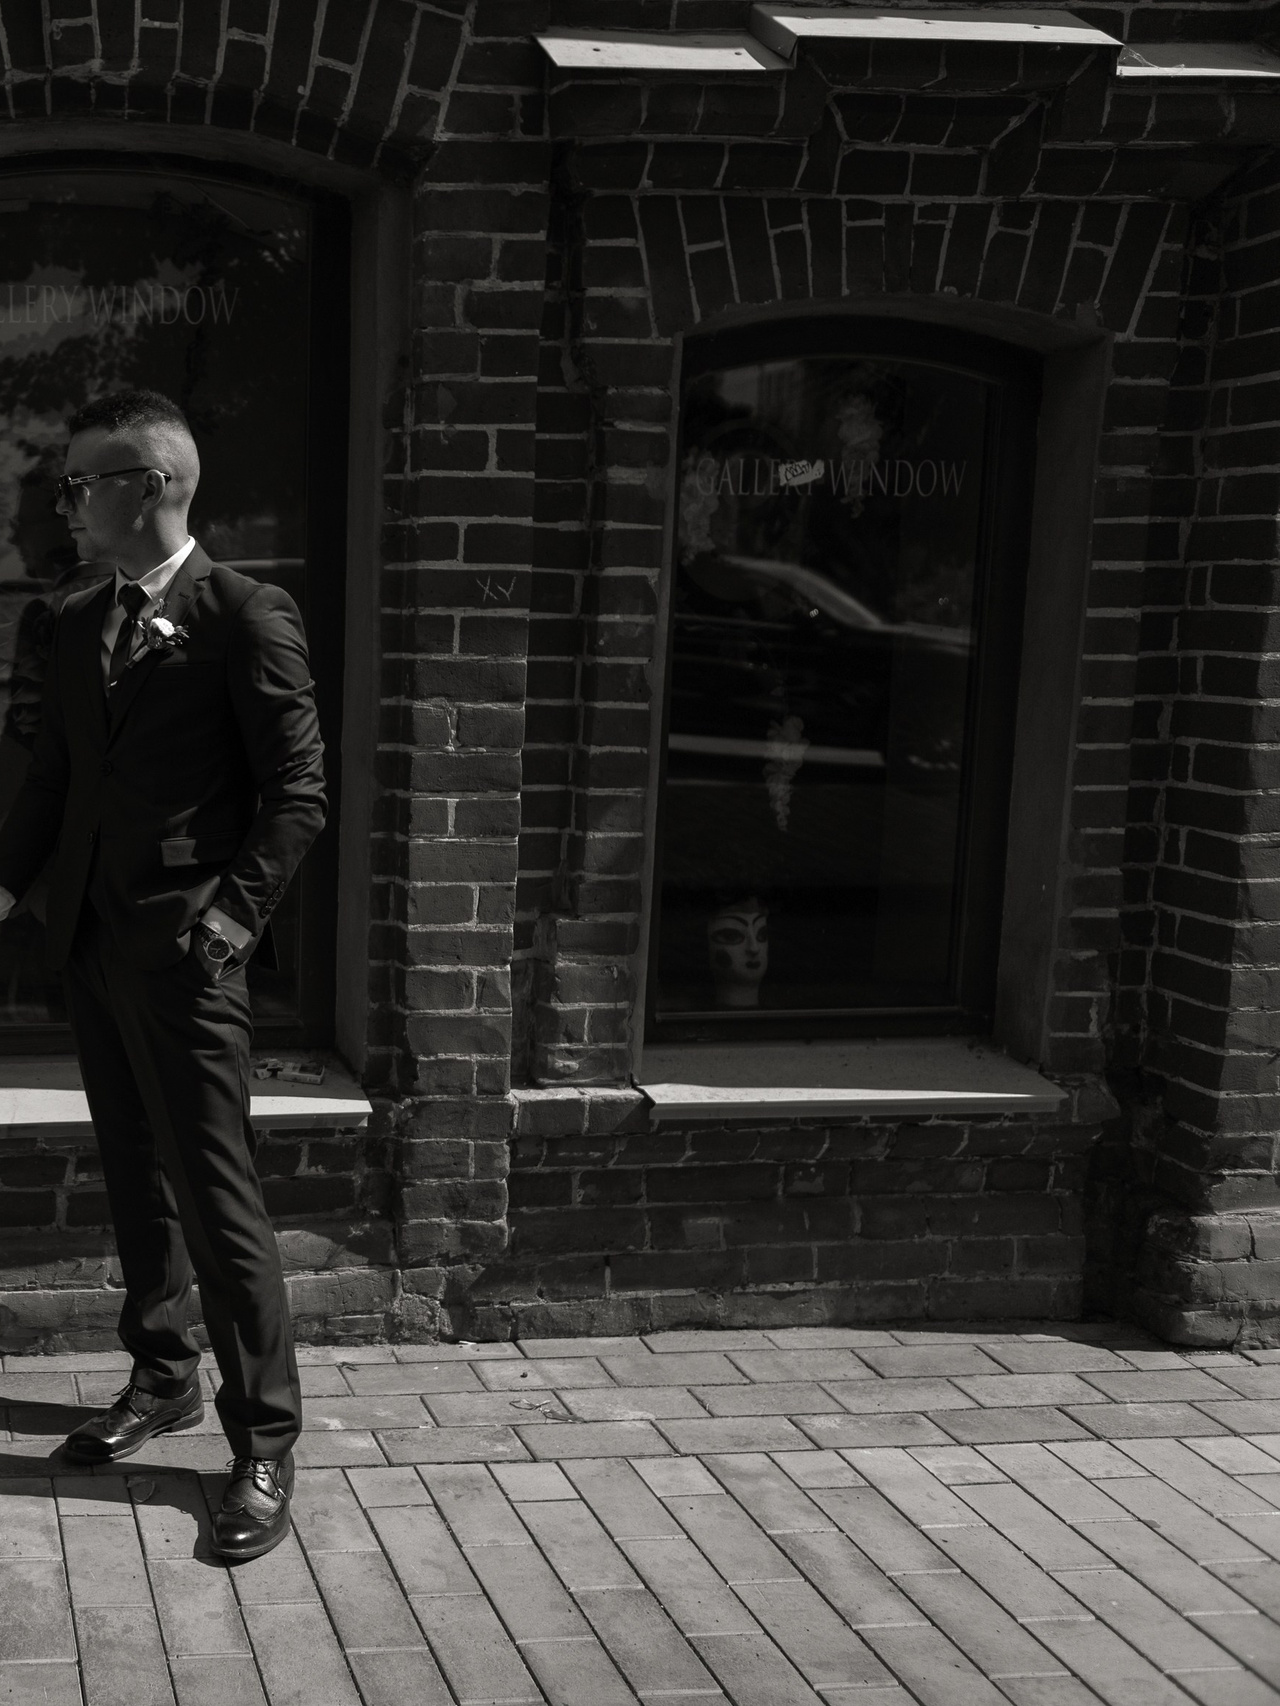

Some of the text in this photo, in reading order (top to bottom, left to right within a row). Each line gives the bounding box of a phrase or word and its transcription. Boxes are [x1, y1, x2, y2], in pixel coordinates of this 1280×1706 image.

[87, 284, 241, 326] WINDOW
[696, 458, 824, 497] GALLE
[828, 458, 967, 498] WINDOW
